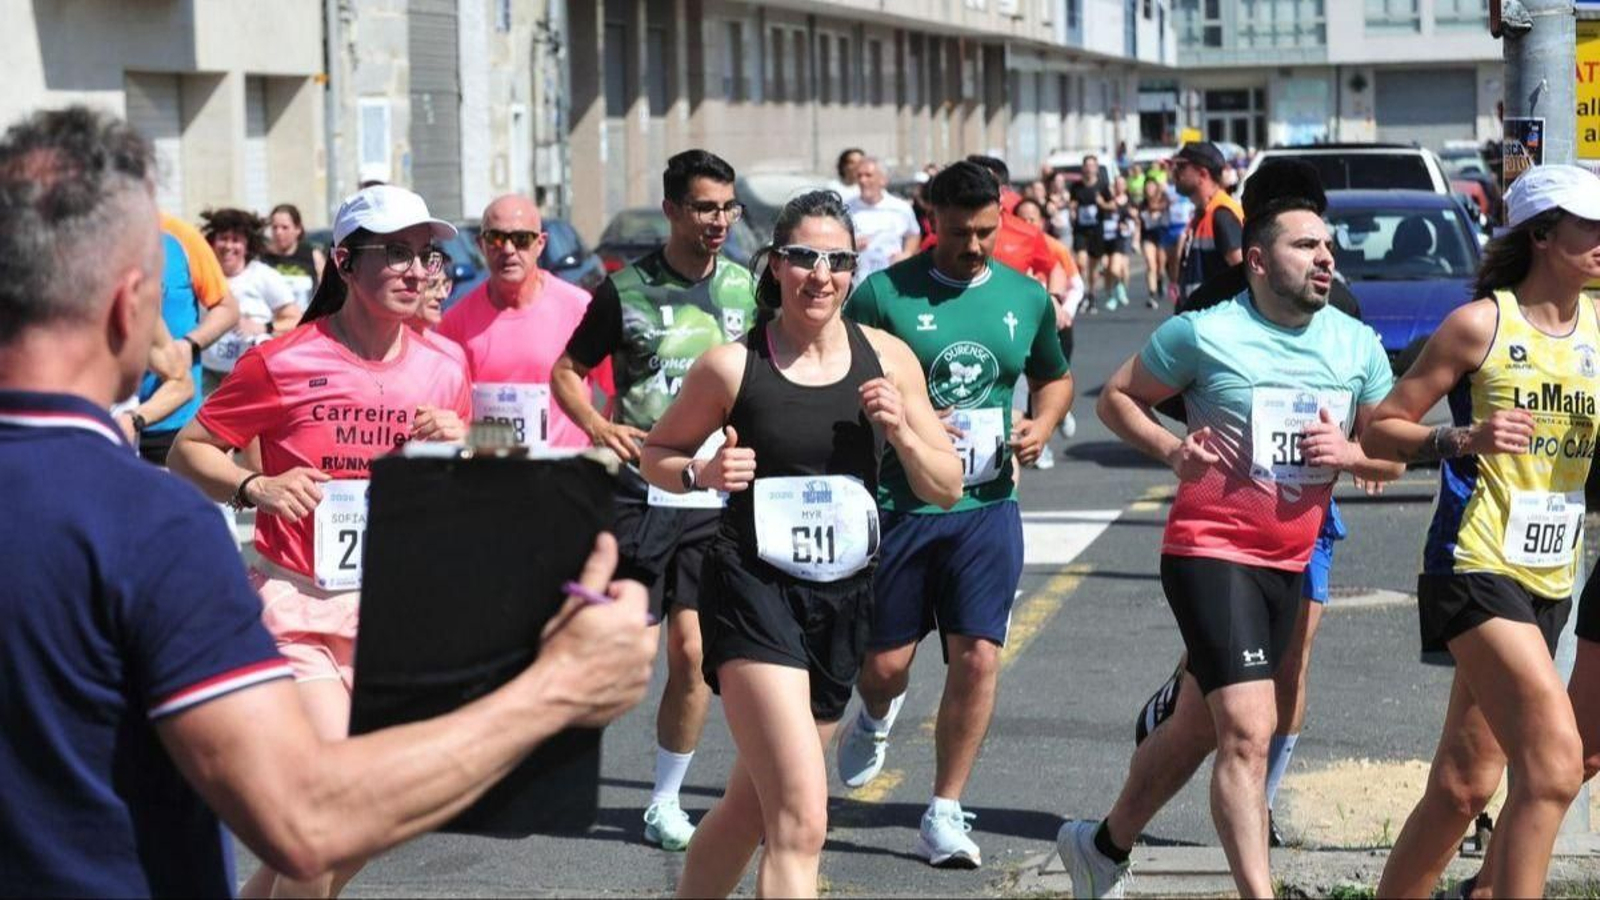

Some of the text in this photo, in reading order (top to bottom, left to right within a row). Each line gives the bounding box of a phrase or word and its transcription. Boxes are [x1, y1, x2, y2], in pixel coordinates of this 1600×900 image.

[660, 305, 674, 327] 1
[944, 344, 990, 363] OURENSE
[312, 405, 408, 424] Carreira
[338, 529, 367, 570] 2
[791, 525, 835, 565] 611
[1523, 523, 1567, 554] 908
